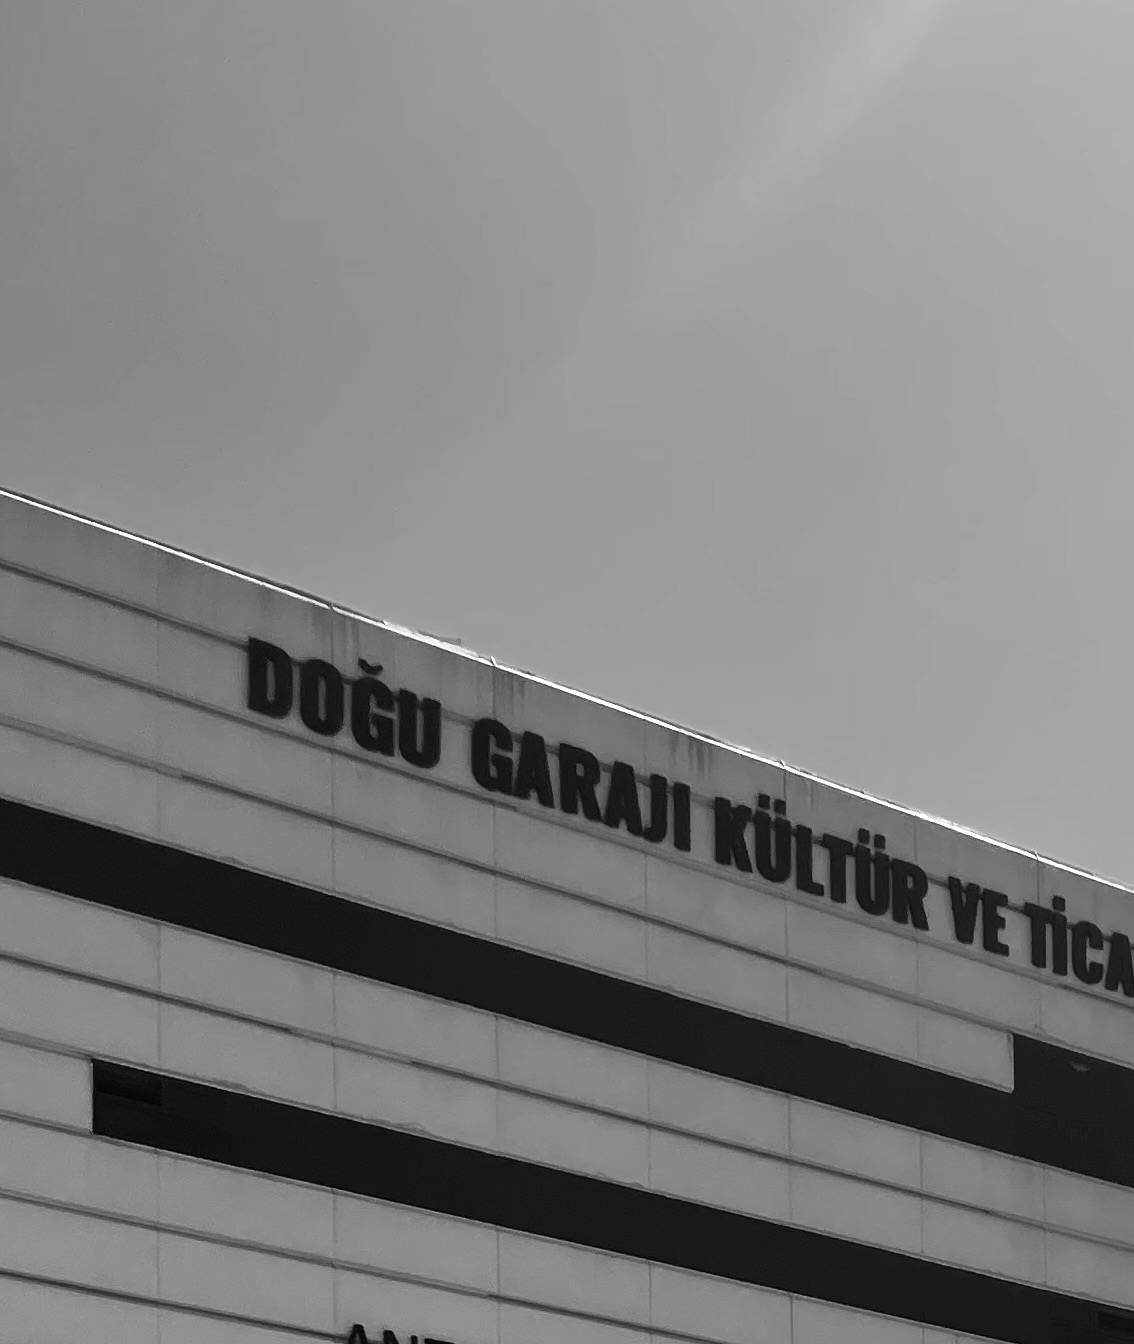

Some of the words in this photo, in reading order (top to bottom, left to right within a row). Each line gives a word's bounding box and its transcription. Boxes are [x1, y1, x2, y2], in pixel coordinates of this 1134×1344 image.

[247, 636, 441, 768] DOĞU
[471, 717, 691, 852] GARAJI
[714, 793, 930, 931] KÜLTÜR
[947, 875, 1009, 957] VE
